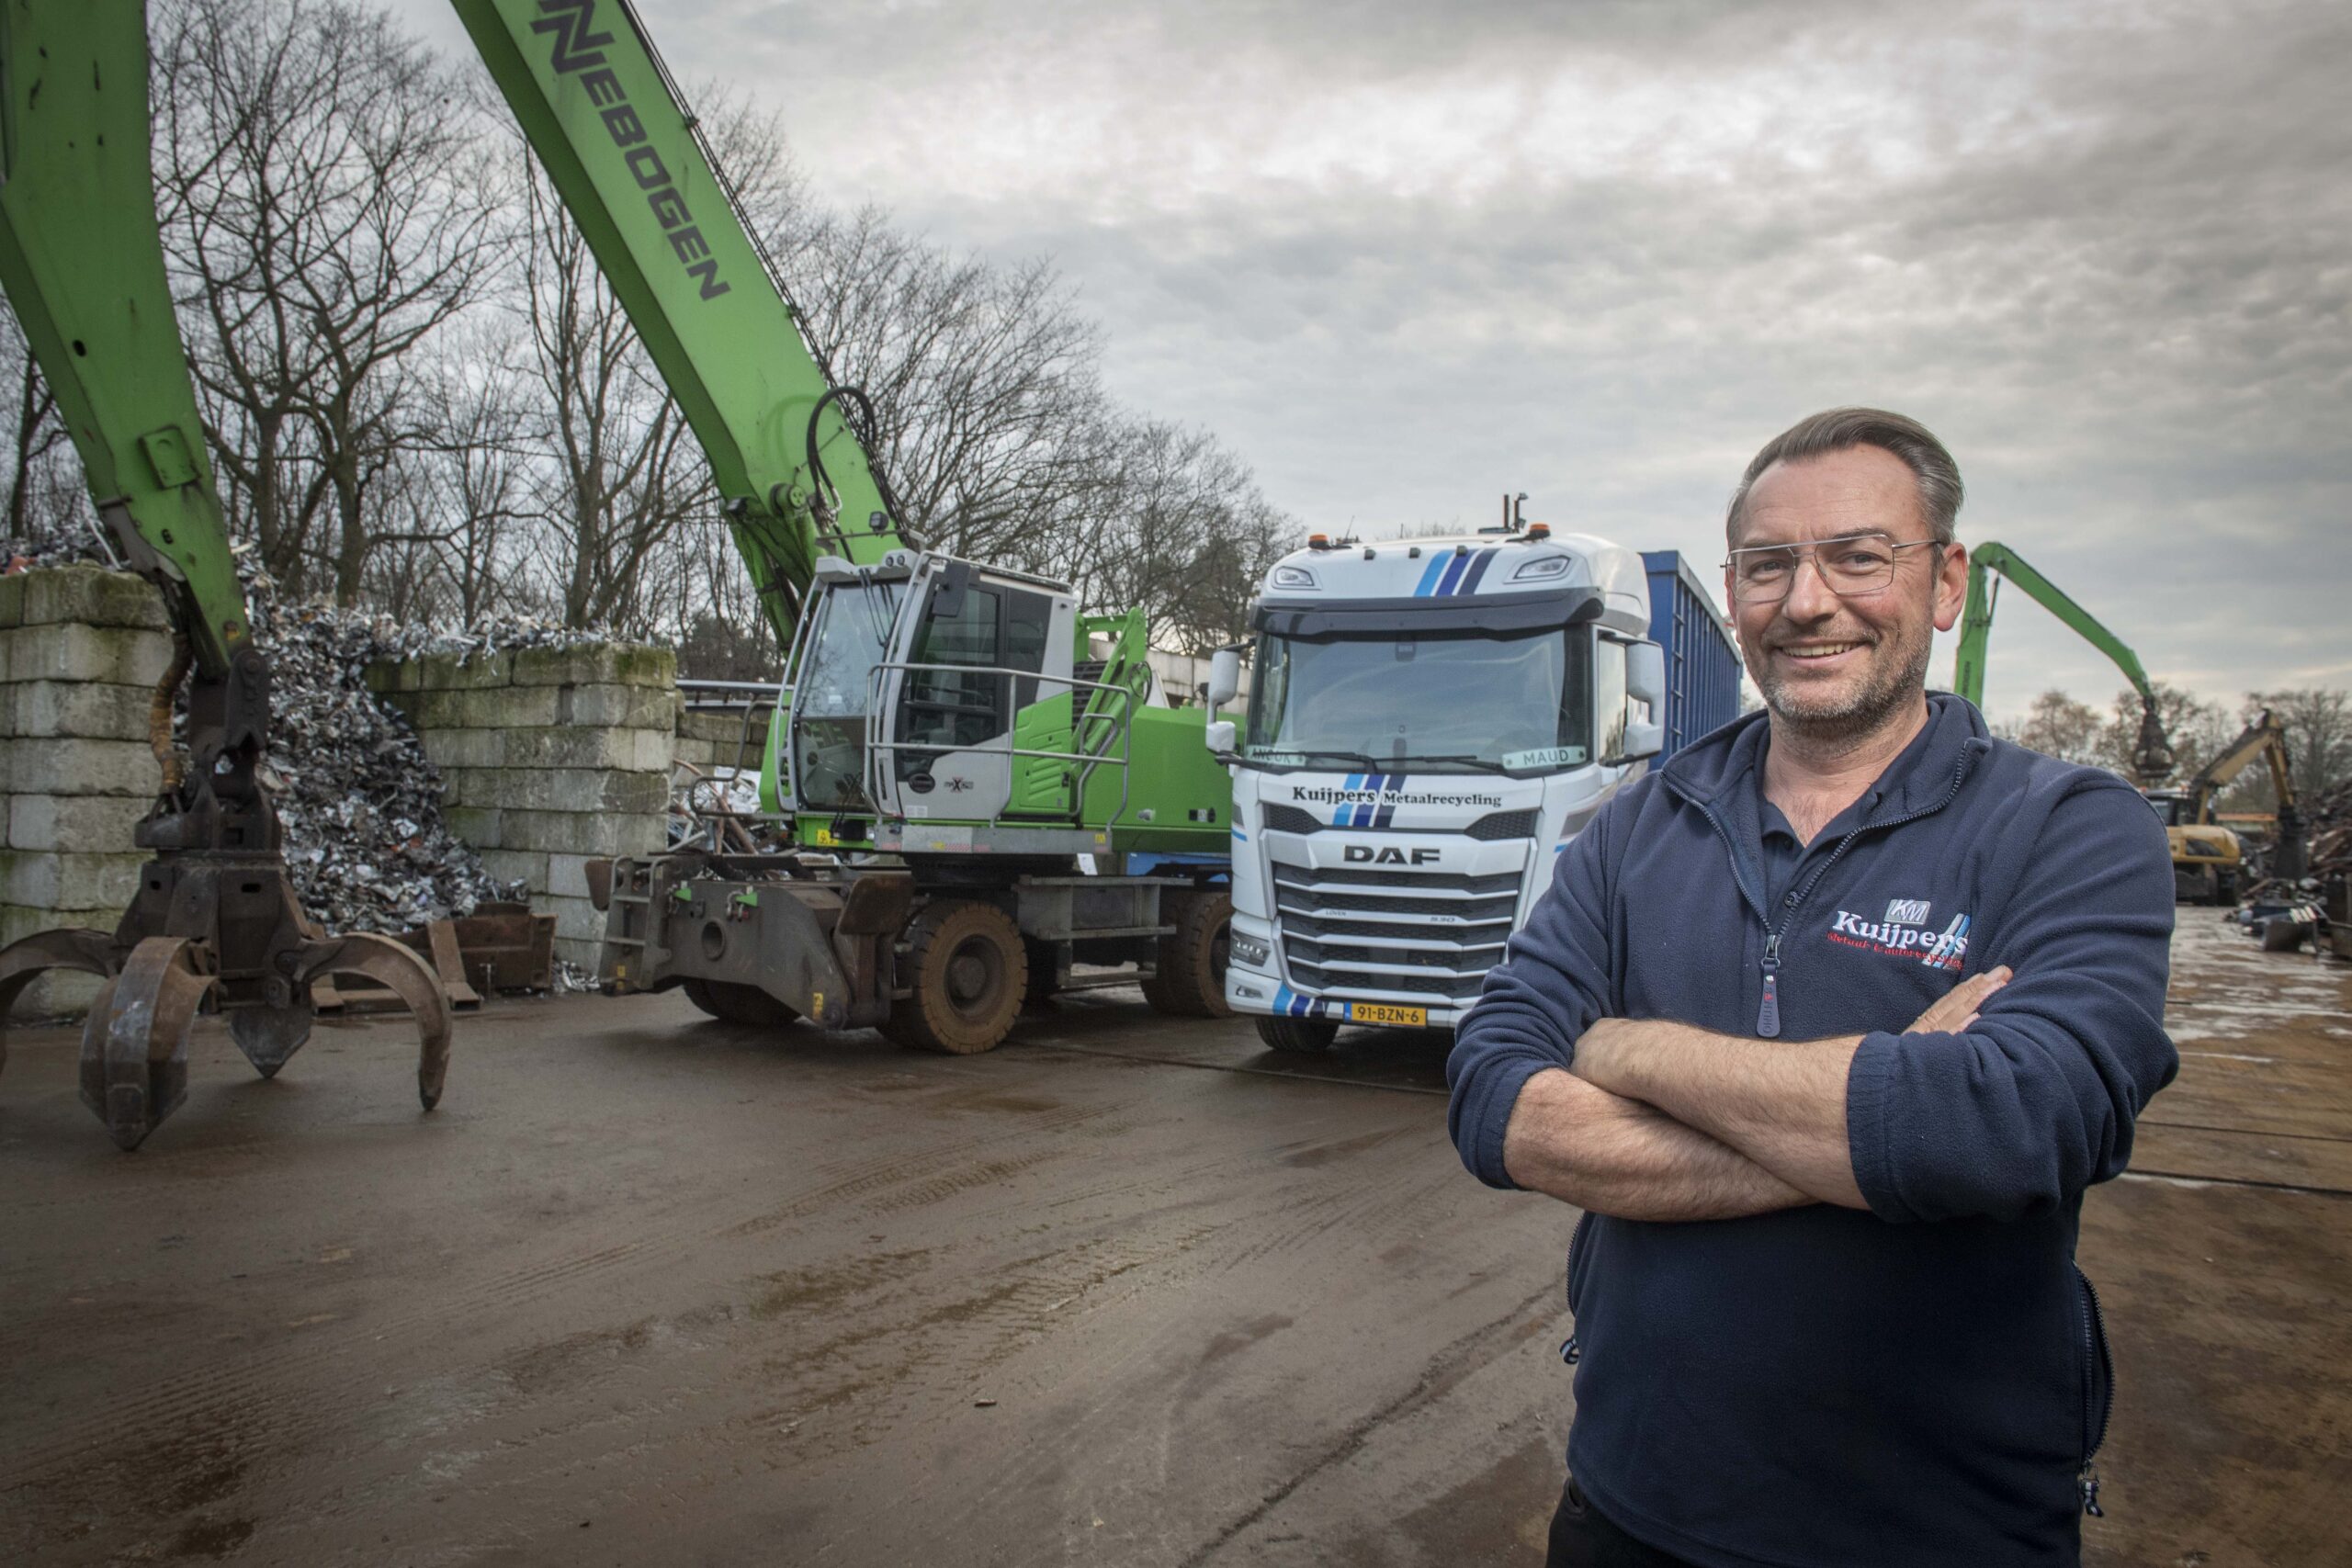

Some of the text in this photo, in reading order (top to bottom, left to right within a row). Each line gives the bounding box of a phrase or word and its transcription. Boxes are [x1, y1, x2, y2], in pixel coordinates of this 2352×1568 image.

[1522, 750, 1569, 765] MAUD
[1293, 786, 1502, 807] Kuijpers Metaalrecycling
[1343, 844, 1441, 865] DAF
[1890, 898, 1928, 921] KM
[1832, 910, 1969, 955] Kuijpers
[1357, 1006, 1419, 1023] 91-BZN-6
